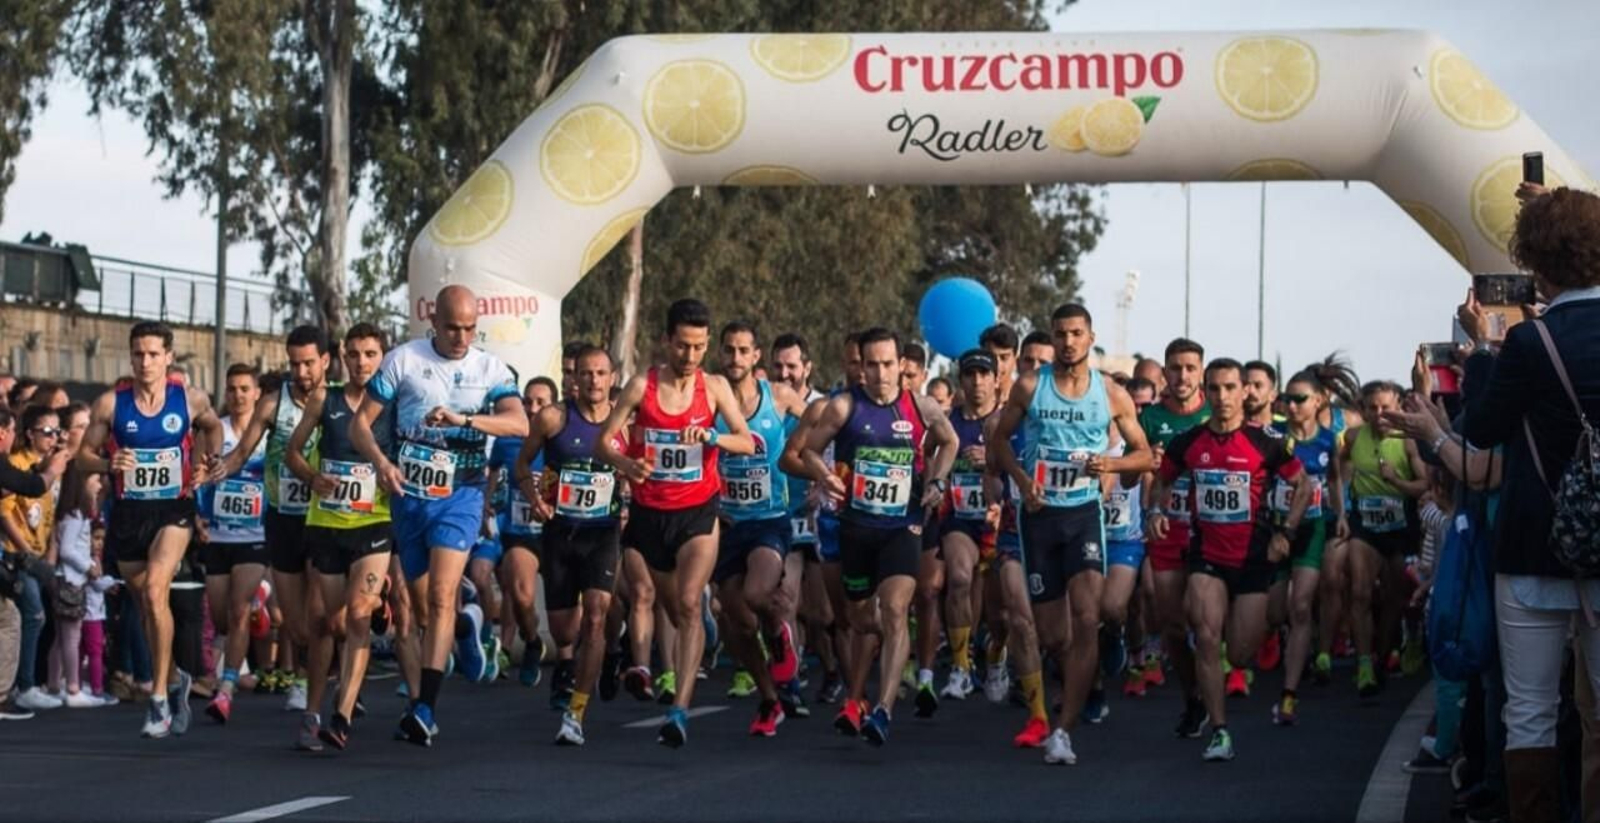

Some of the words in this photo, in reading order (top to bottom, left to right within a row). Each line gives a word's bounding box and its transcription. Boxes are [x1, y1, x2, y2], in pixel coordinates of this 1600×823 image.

[853, 45, 1184, 97] Cruzcampo
[887, 110, 1048, 161] Radler
[416, 295, 539, 321] Crampo
[1038, 409, 1085, 423] nerja
[661, 449, 687, 469] 60
[135, 467, 170, 487] 878
[403, 462, 447, 487] 1200
[1050, 467, 1078, 487] 117
[575, 489, 596, 507] 79
[728, 482, 762, 501] 656
[865, 480, 898, 503] 341
[1204, 490, 1239, 510] 498
[221, 497, 253, 515] 465
